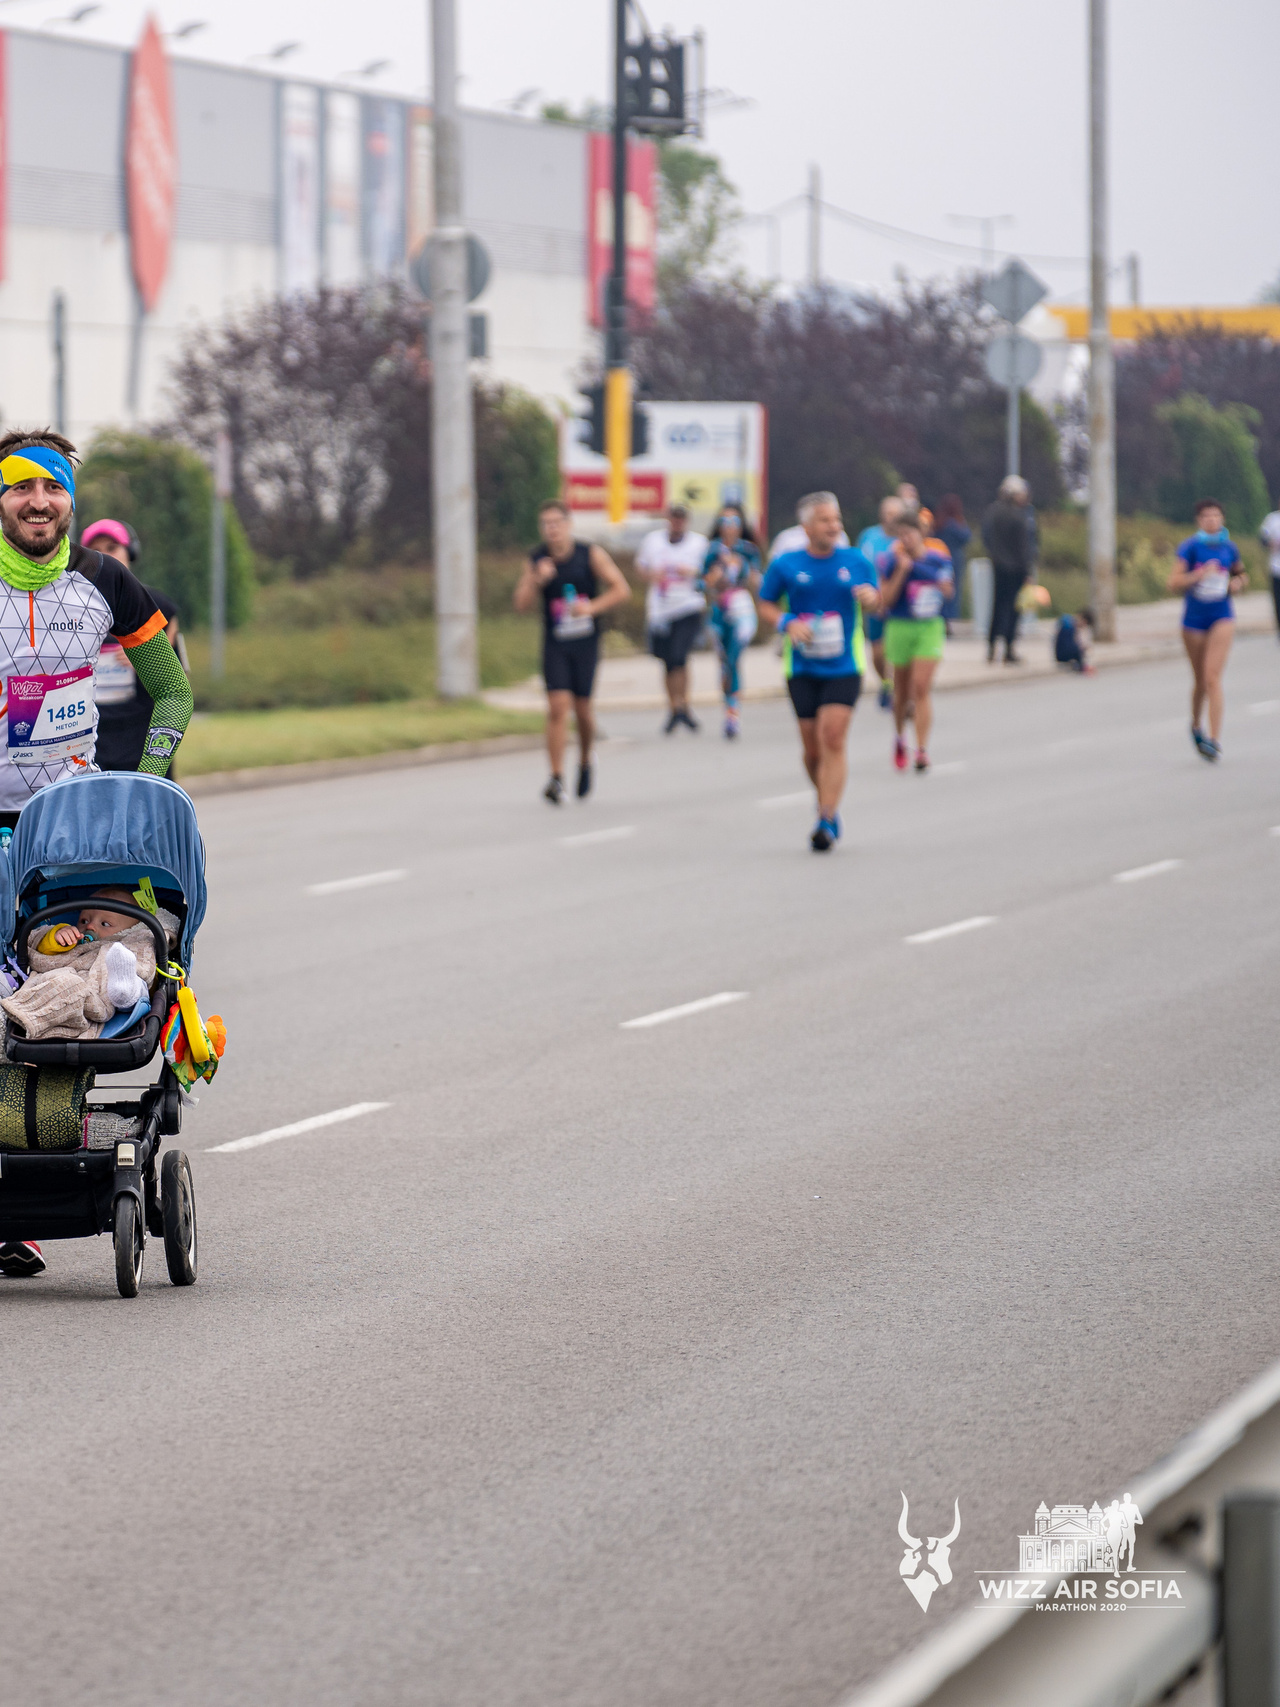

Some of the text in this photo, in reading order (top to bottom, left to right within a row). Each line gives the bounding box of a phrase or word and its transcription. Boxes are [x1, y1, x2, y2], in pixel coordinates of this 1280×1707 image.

[49, 618, 84, 631] modis
[47, 700, 86, 723] 1485
[55, 721, 78, 731] METODI
